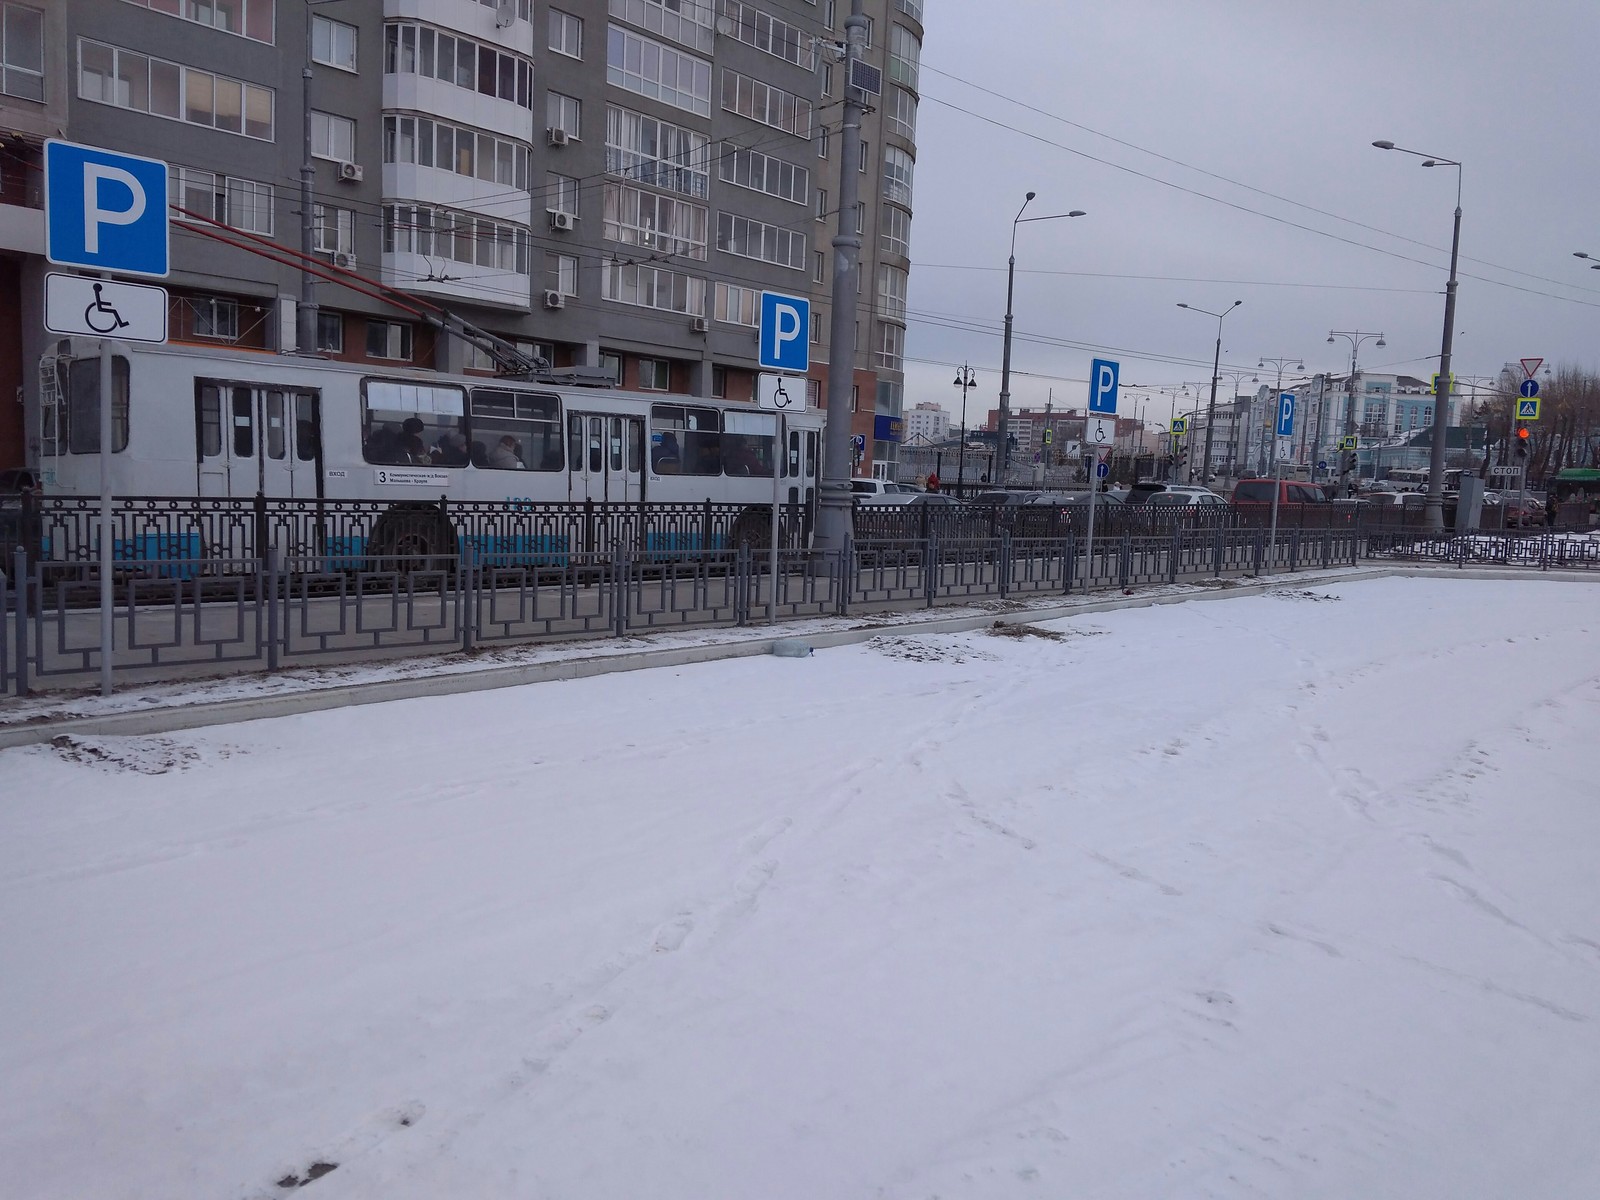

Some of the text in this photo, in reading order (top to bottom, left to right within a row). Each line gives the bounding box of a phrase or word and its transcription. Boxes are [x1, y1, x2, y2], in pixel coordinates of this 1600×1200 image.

[83, 161, 147, 254] P
[774, 304, 801, 359] P
[1097, 366, 1114, 407] P
[1281, 398, 1292, 431] P
[379, 471, 387, 483] 3
